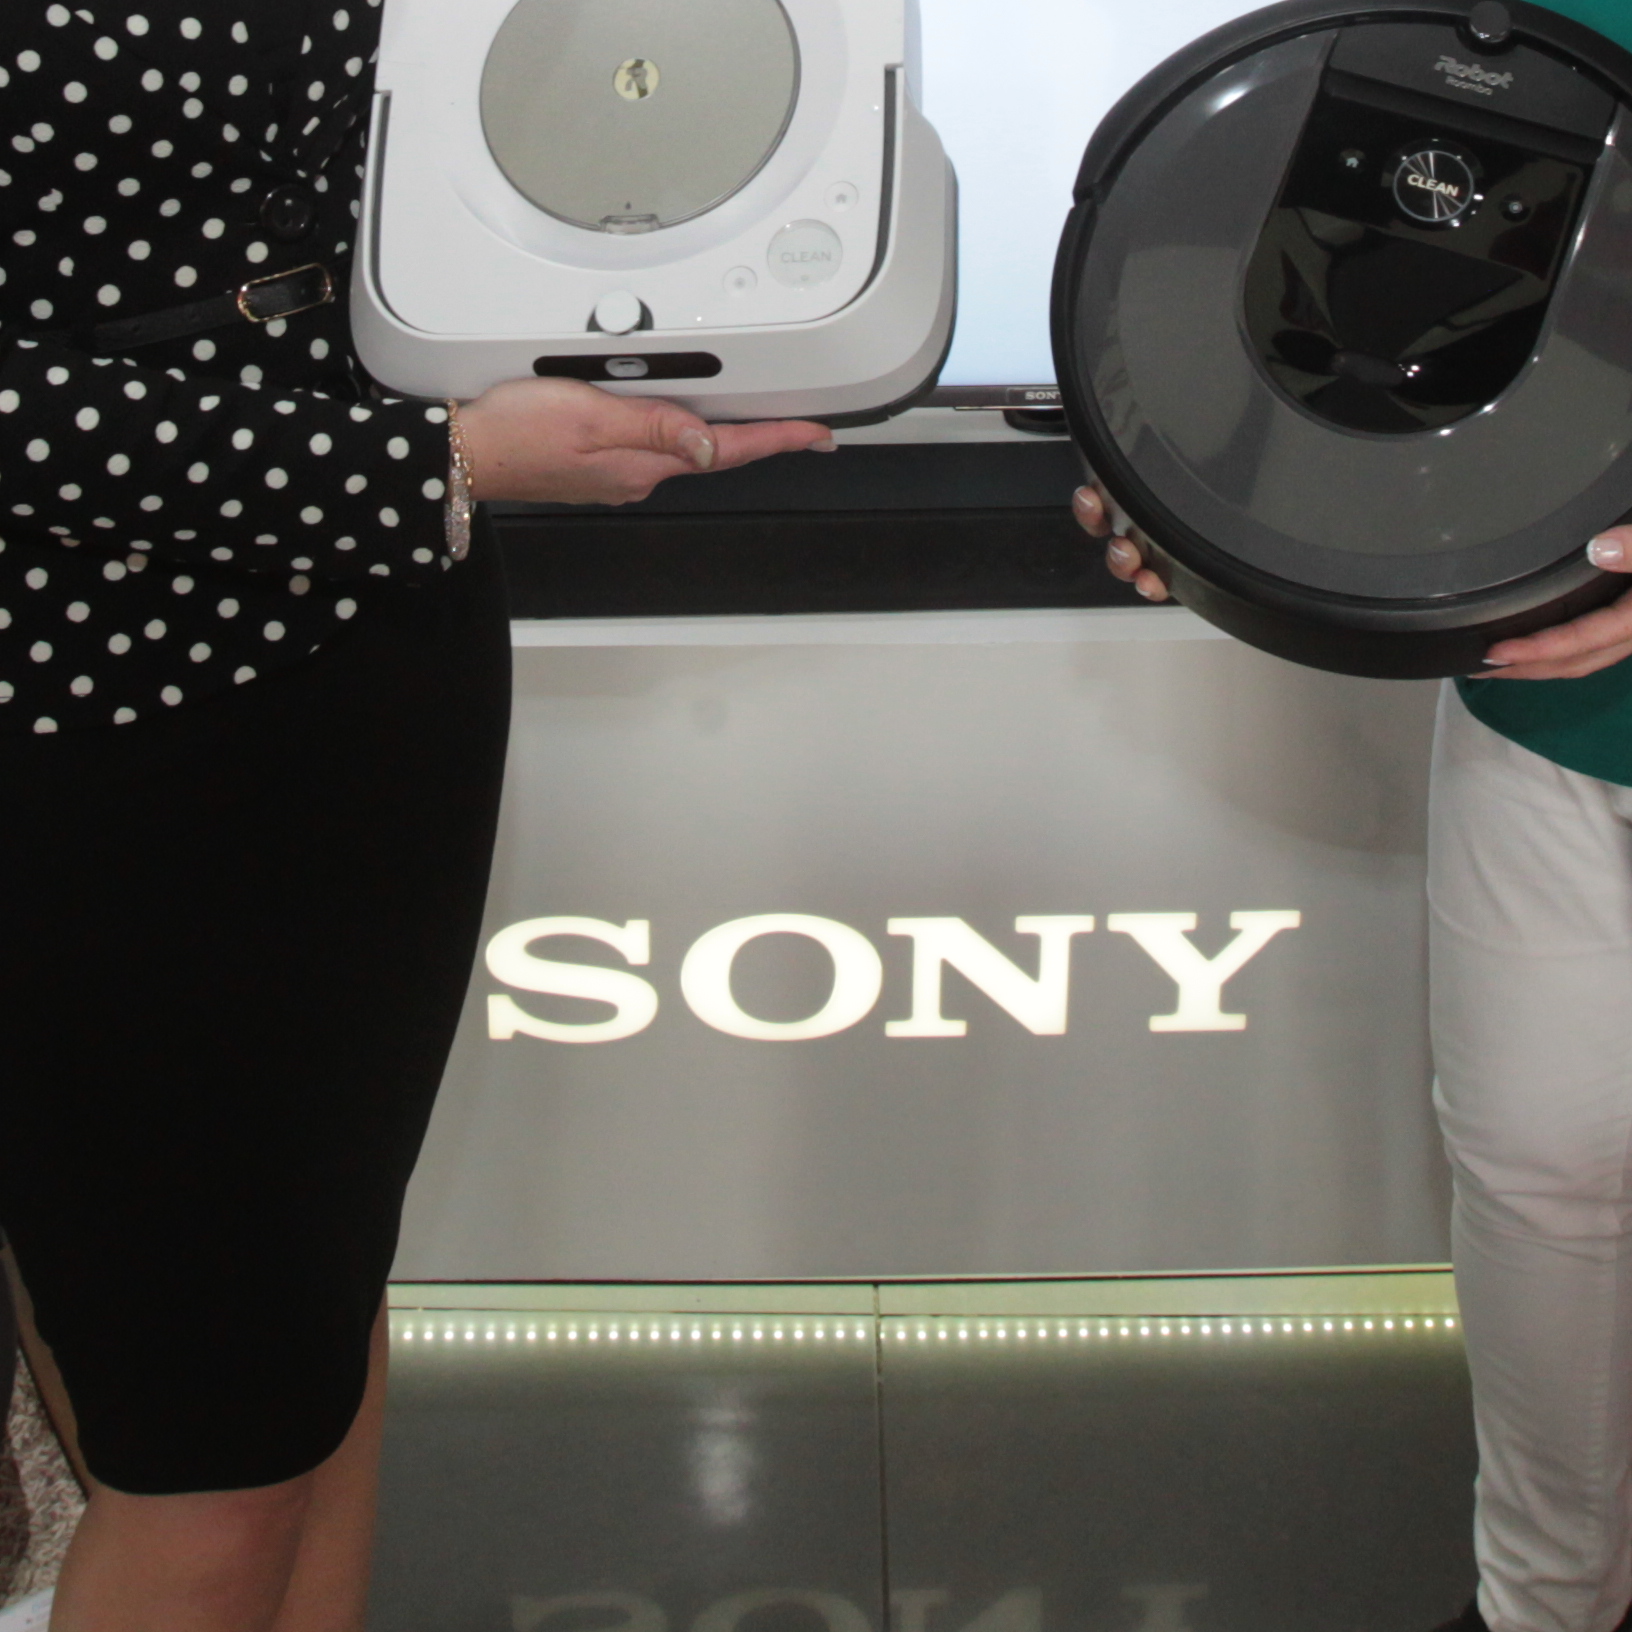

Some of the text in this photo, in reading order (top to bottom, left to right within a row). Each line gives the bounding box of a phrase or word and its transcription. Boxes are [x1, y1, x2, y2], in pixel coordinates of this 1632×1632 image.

[1445, 75, 1493, 96] Roomba
[1407, 173, 1459, 197] CLEAN
[780, 248, 834, 266] CLEAN
[484, 909, 1303, 1044] SONY
